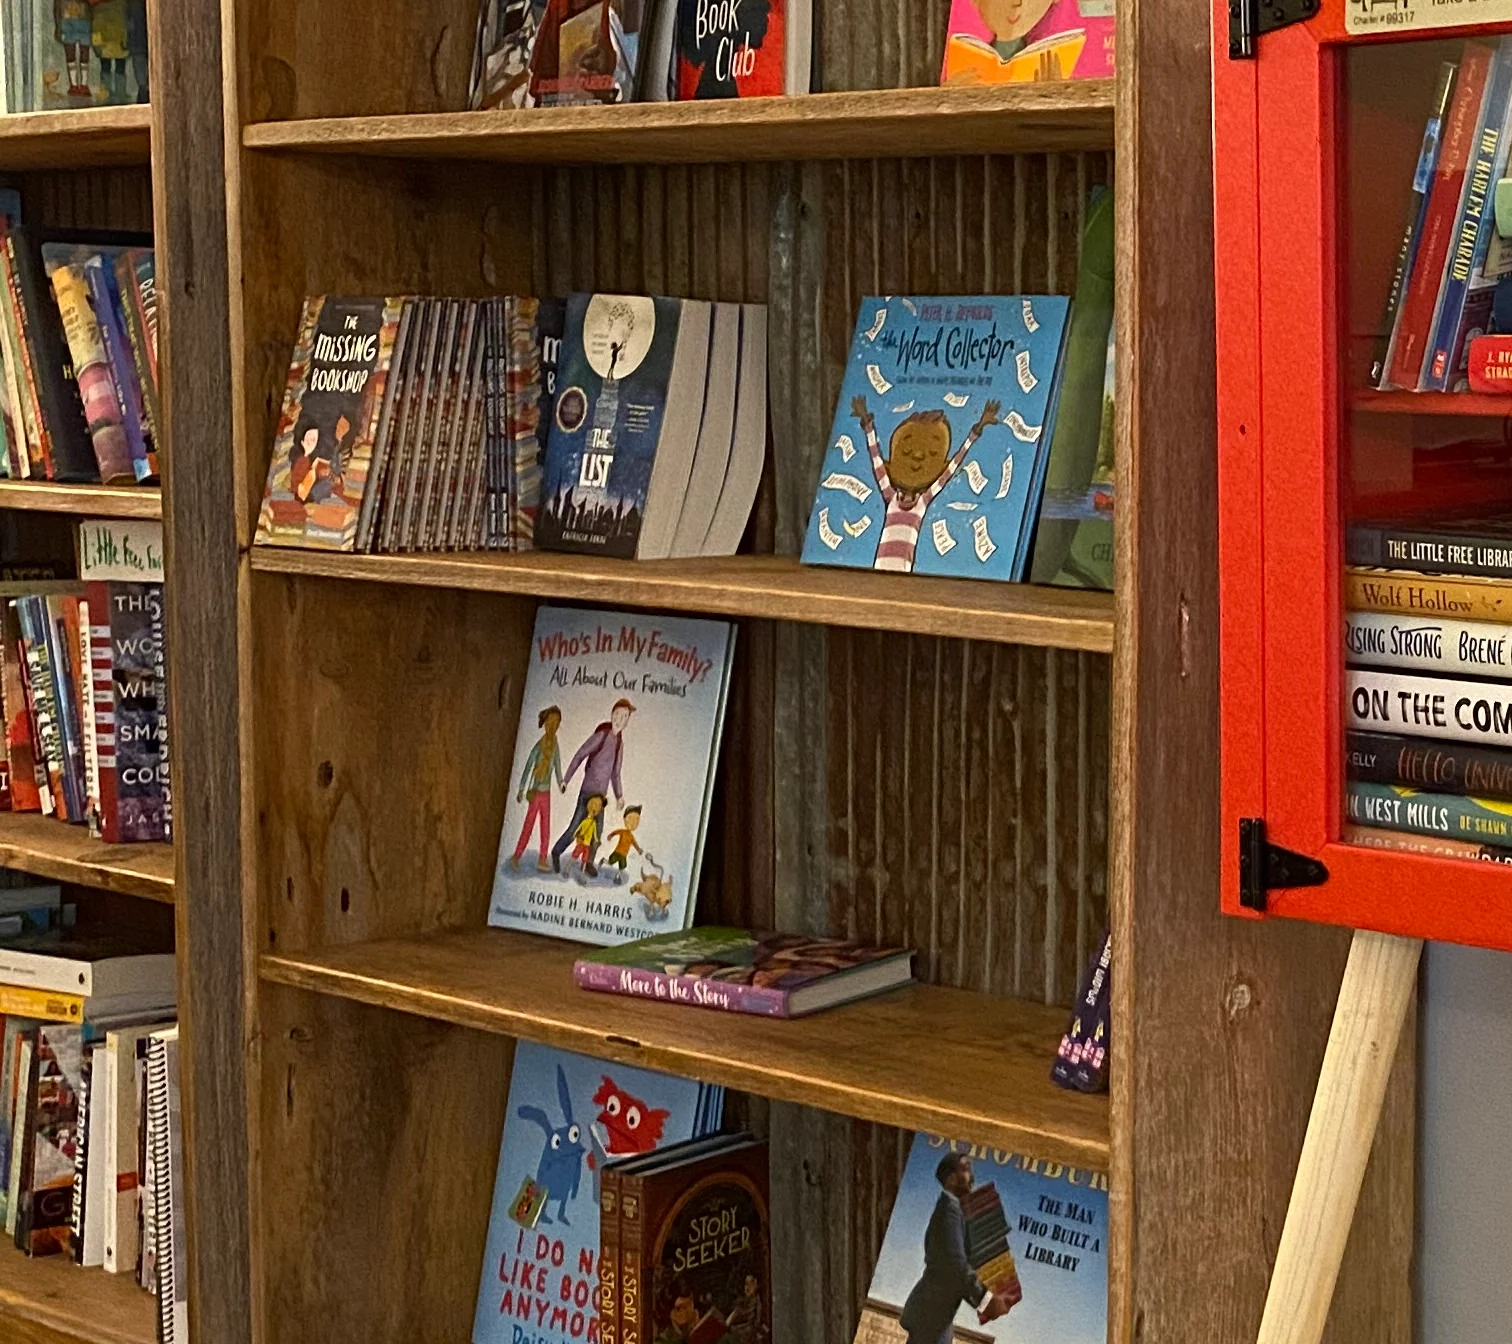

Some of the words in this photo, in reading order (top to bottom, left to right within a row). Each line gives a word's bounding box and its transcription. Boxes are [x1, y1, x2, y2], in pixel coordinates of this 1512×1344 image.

[715, 31, 755, 81] Club
[341, 316, 359, 330] THE
[896, 325, 944, 373] Word
[946, 321, 1015, 372] Collector
[311, 367, 369, 394] BOOKSHOP
[591, 429, 613, 449] THE
[578, 453, 615, 489] LIST
[83, 527, 120, 569] Little
[1388, 540, 1407, 559] THE
[1411, 543, 1444, 562] LITTLE
[1448, 546, 1473, 565] FREE
[1362, 583, 1401, 607] Wolf
[1408, 588, 1473, 613] Hollow
[538, 632, 591, 663] Who's
[595, 626, 612, 653] In
[618, 626, 646, 663] My
[649, 630, 713, 684] Family?
[1390, 626, 1442, 659] STRONG
[1459, 631, 1505, 665] BRENÉ
[550, 666, 568, 688] All
[573, 667, 607, 689] About
[613, 671, 637, 690] Our
[642, 675, 687, 698] Families
[1352, 687, 1390, 722] ON
[1397, 692, 1448, 728] THE
[1347, 750, 1377, 767] ELLY
[1398, 745, 1456, 782] HELLO
[1364, 798, 1401, 824] WEST
[1407, 803, 1449, 832] MILLS
[528, 891, 563, 909] ROBIE
[586, 901, 632, 920] HARRIS
[530, 910, 565, 926] NADINE
[569, 917, 612, 933] BERNARD
[619, 970, 653, 994] More
[656, 975, 667, 996] to
[669, 978, 690, 1000] the
[693, 981, 730, 1007] Story
[70, 1174, 84, 1237] STREET
[1038, 1194, 1061, 1217] THE
[1064, 1201, 1095, 1225] MAN
[688, 1206, 738, 1244] STORY
[1018, 1214, 1048, 1237] WHO
[1051, 1224, 1091, 1249] BUILT
[517, 1229, 524, 1254] I
[536, 1234, 564, 1267] DO
[673, 1226, 750, 1272] SEEKER
[1024, 1242, 1080, 1272] LIBRARY
[499, 1252, 548, 1294] LIKE
[601, 1266, 614, 1316] STORY
[622, 1276, 636, 1323] STORY
